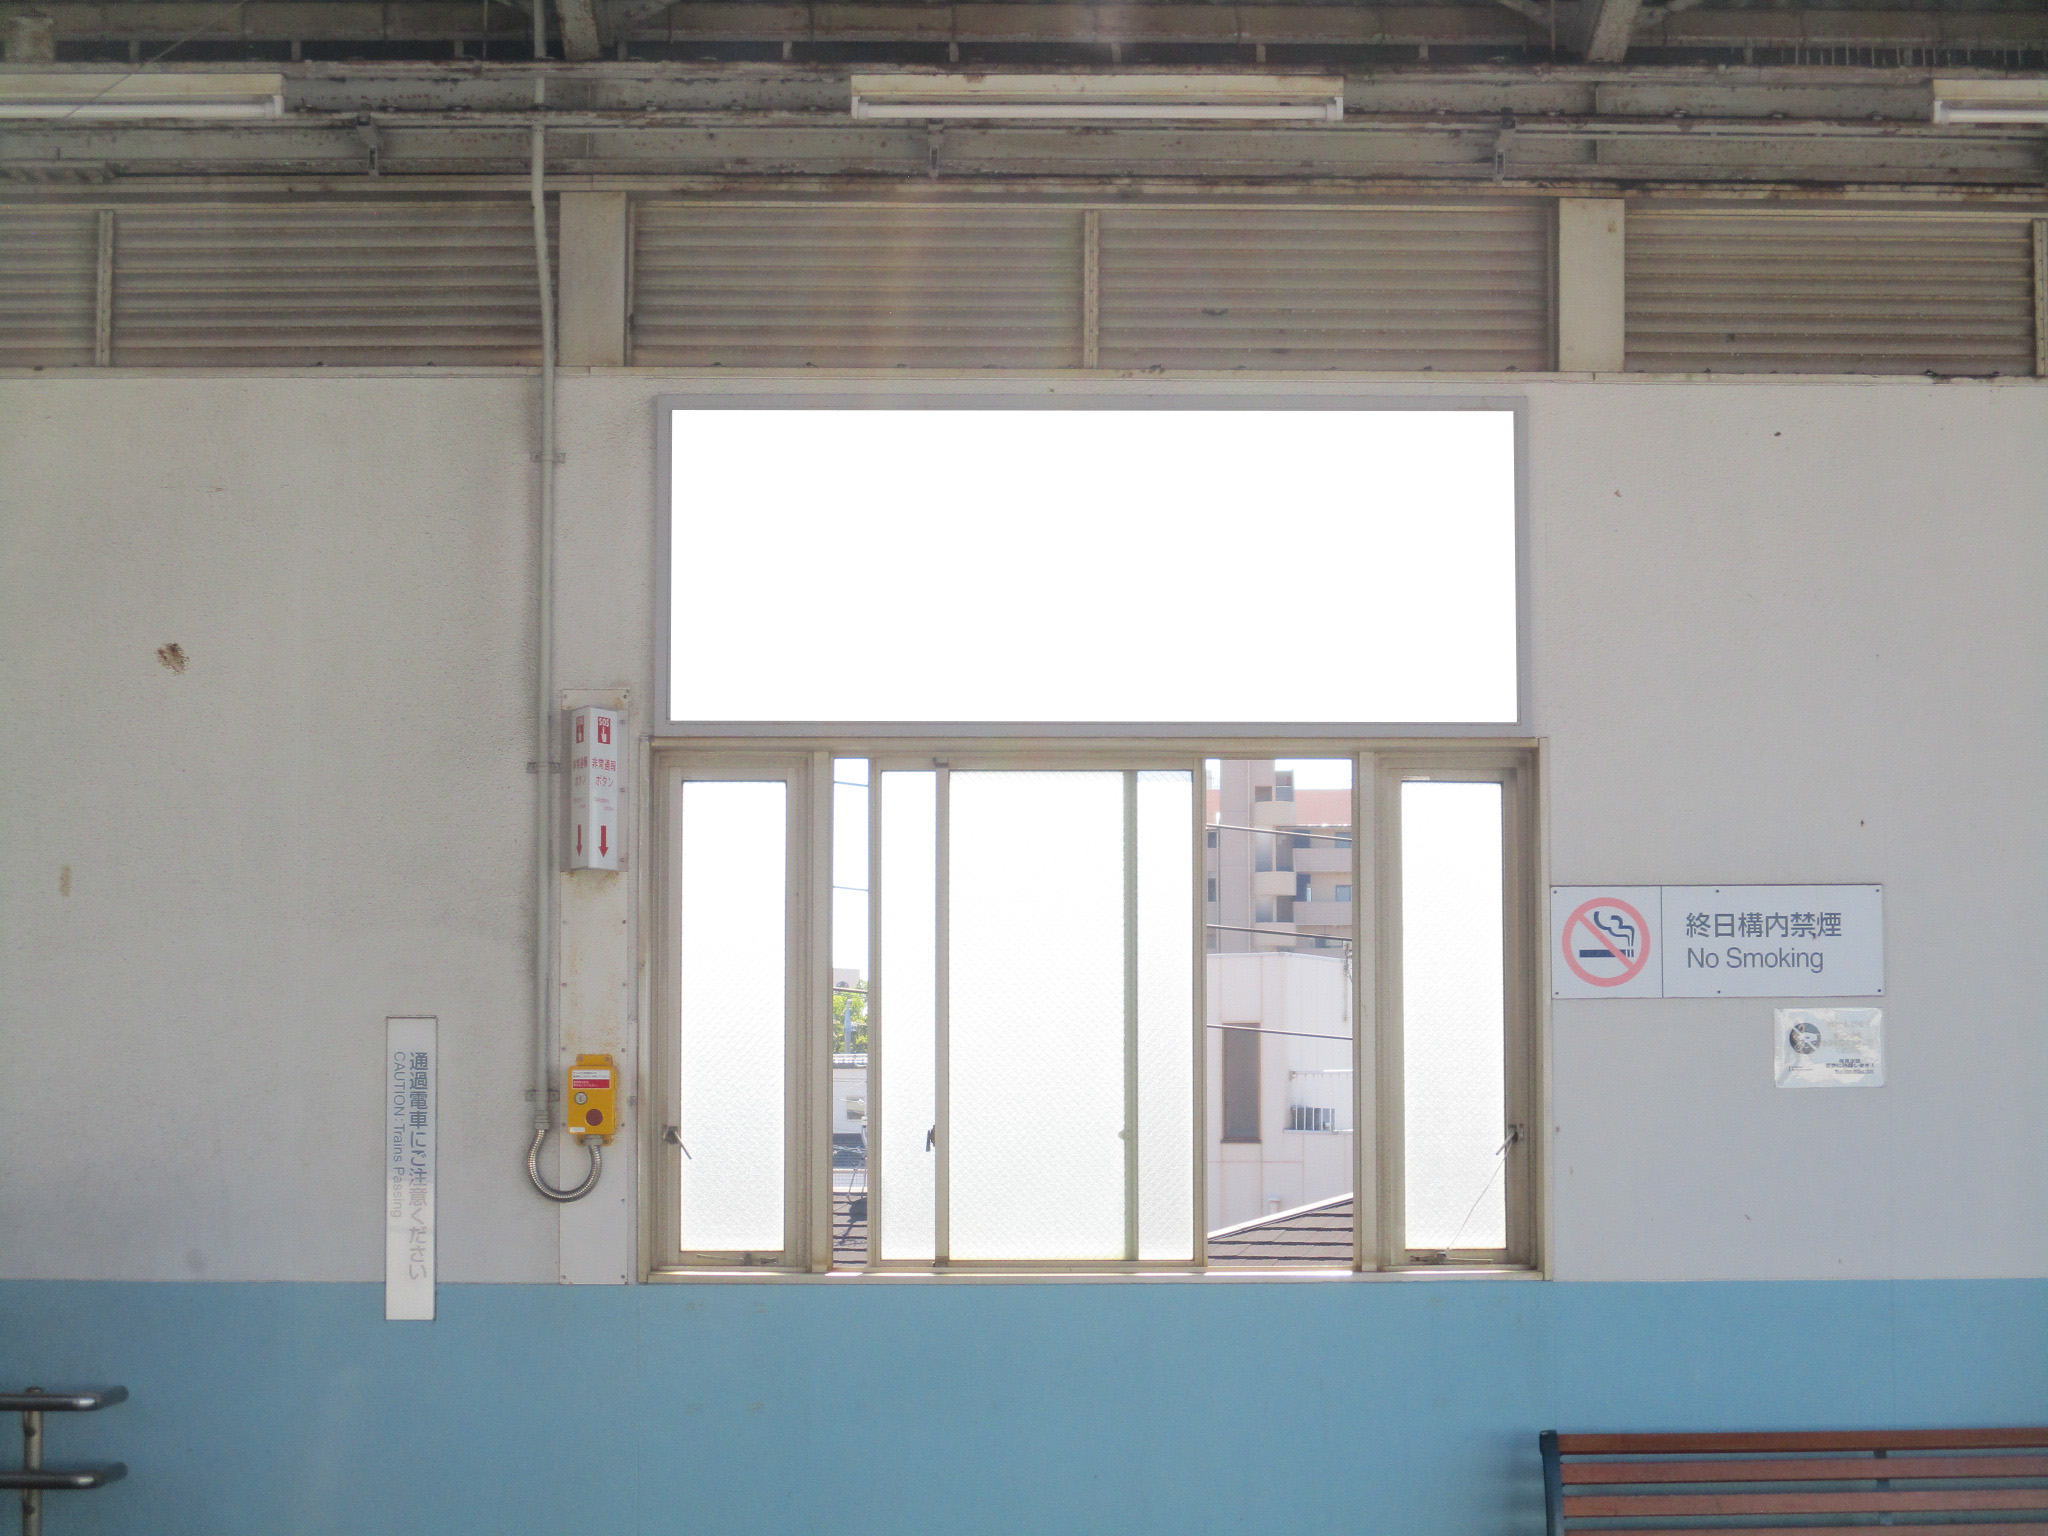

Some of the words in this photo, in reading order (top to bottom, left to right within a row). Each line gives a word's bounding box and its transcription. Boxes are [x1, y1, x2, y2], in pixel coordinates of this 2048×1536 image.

[598, 717, 609, 726] SOS
[592, 757, 616, 772] 非常通報
[595, 775, 614, 788] ボタン
[1685, 911, 1842, 938] 終日構内禁煙
[1687, 948, 1719, 969] No
[1726, 947, 1824, 973] Smoking
[392, 1124, 406, 1163] Trains
[409, 1051, 428, 1281] 通過電車にご注意ください
[390, 1167, 405, 1218] Passing
